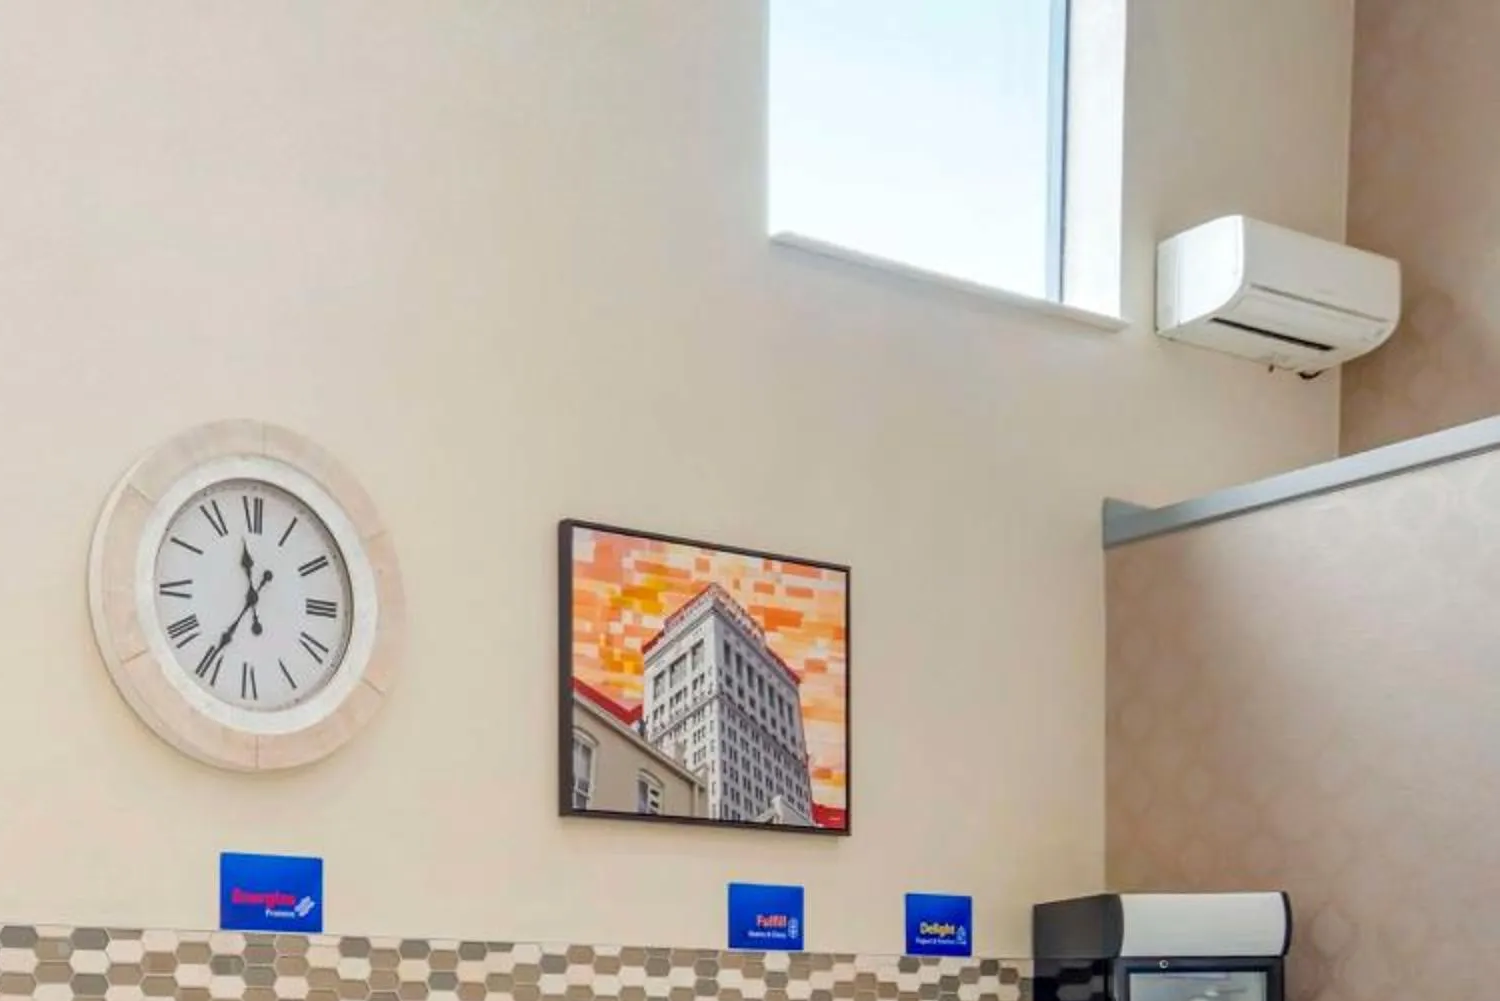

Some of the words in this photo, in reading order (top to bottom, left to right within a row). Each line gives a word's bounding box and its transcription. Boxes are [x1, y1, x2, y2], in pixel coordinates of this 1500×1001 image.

[297, 555, 329, 577] II
[305, 597, 338, 619] III
[920, 922, 955, 937] Delight
